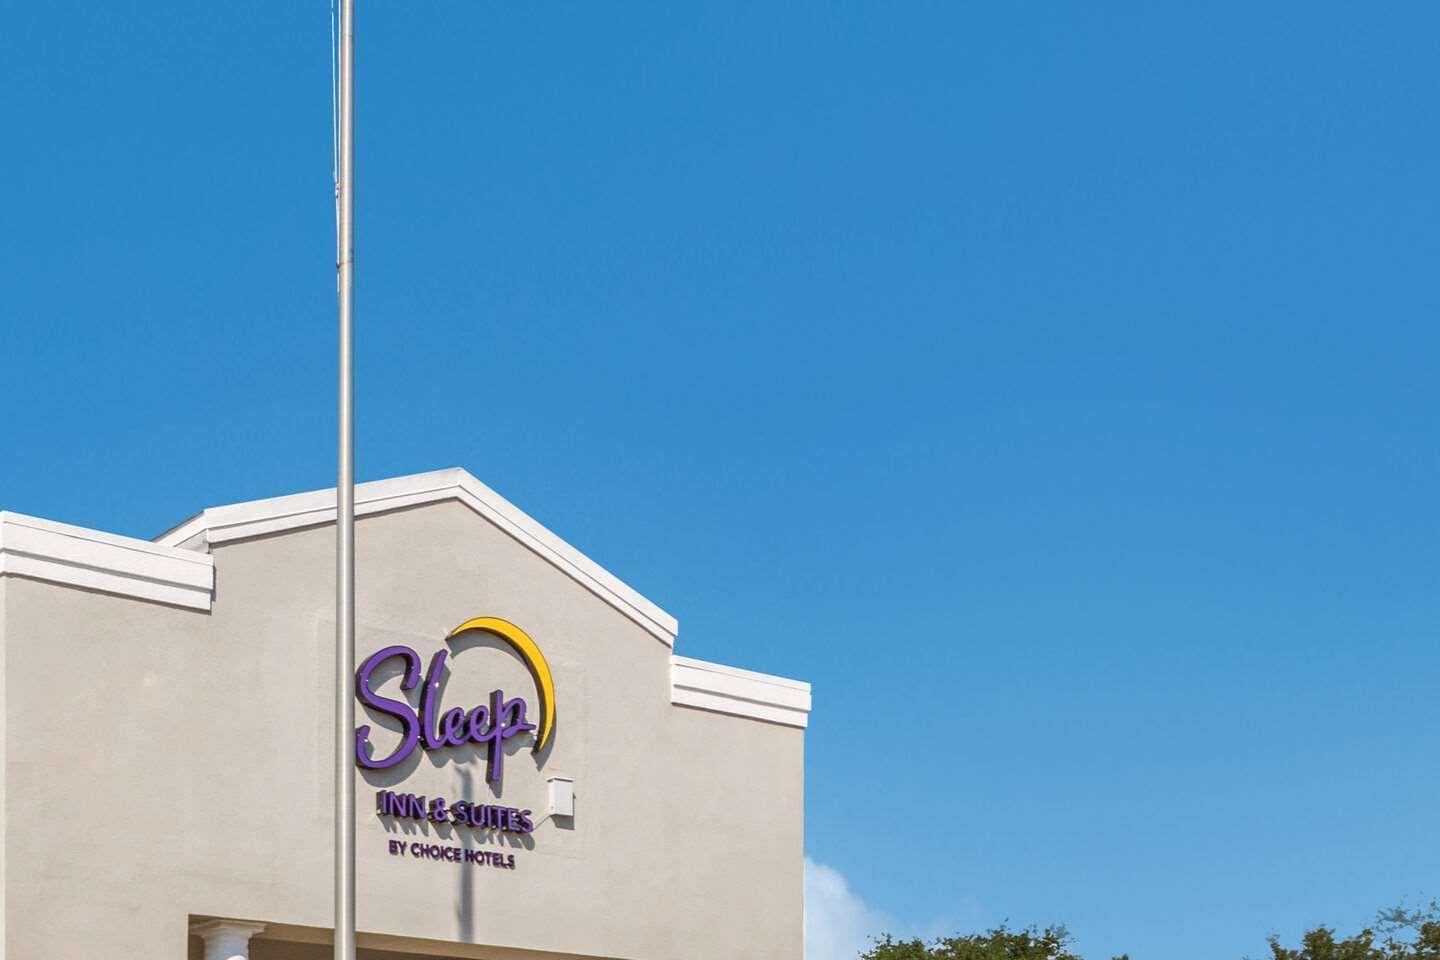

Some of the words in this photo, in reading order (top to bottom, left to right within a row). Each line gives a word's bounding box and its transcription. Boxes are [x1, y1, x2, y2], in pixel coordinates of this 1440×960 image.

[355, 645, 536, 780] Sleep
[377, 790, 426, 819] INN
[430, 797, 449, 823] &
[453, 800, 534, 833] SUITES
[389, 840, 407, 856] BY
[410, 843, 461, 863] CHOICE
[464, 849, 516, 869] HOTELS
